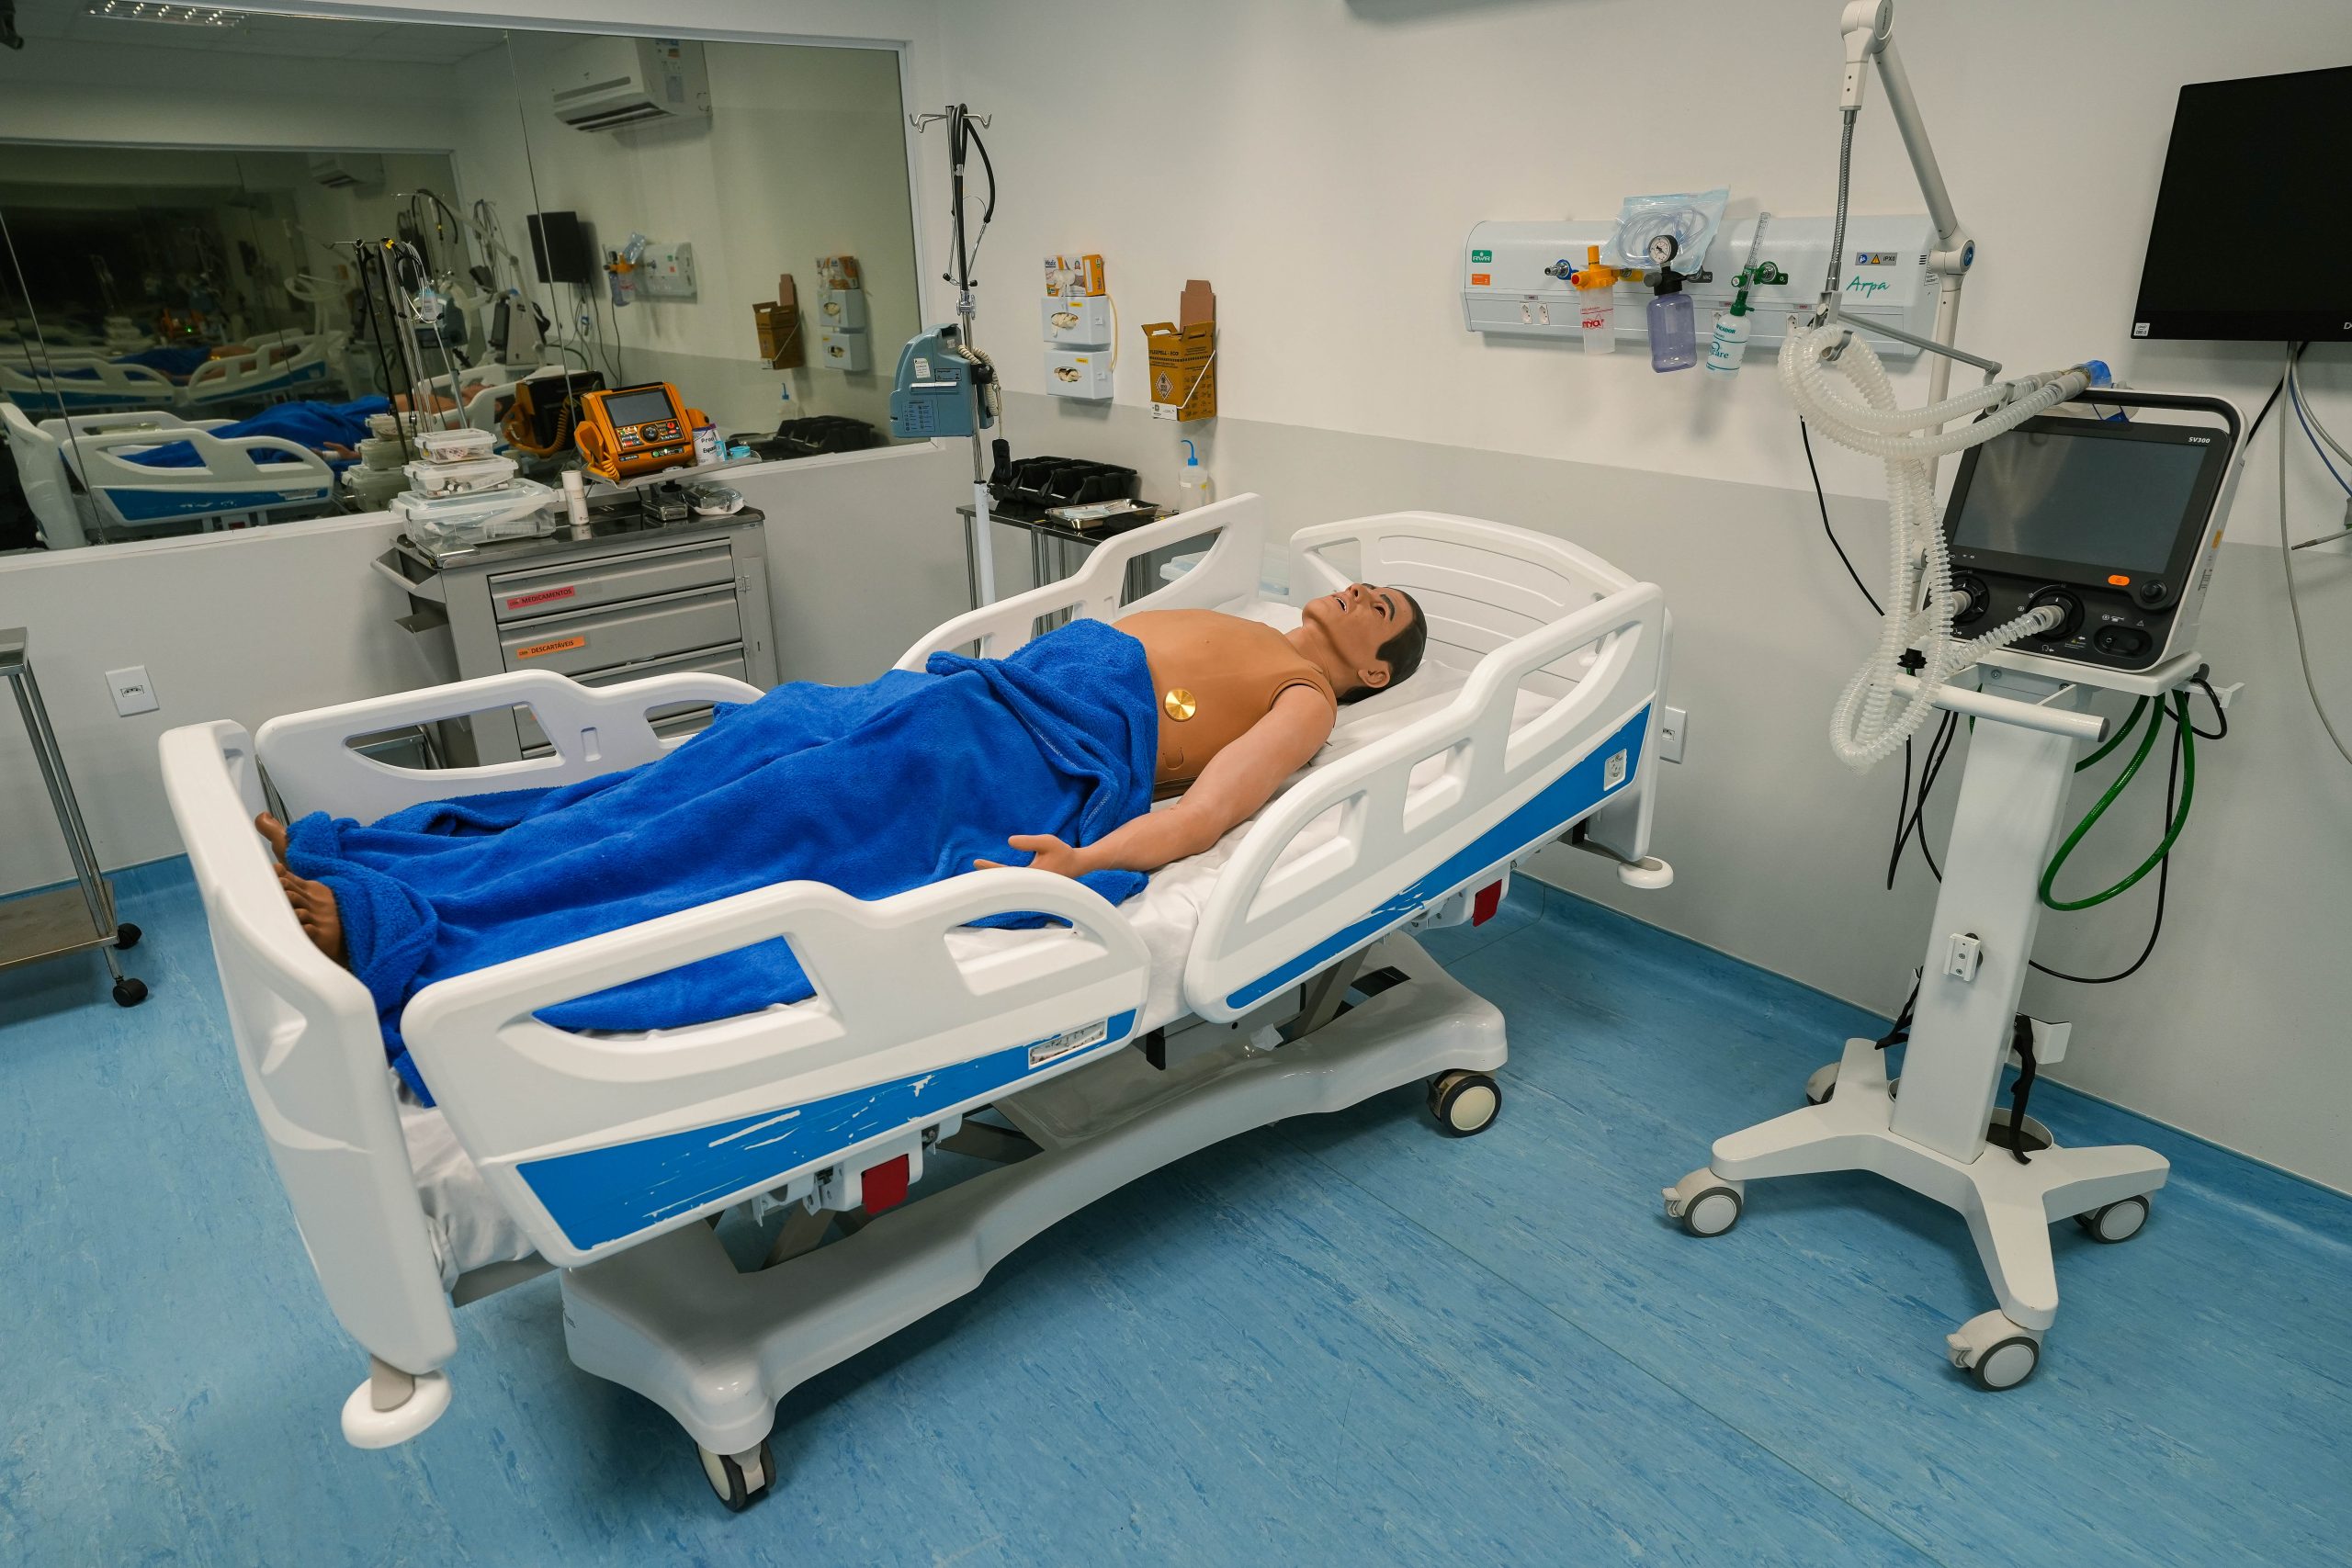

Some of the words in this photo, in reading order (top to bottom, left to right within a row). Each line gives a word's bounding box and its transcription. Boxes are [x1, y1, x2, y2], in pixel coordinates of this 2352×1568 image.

[1846, 276, 1890, 299] Arpa
[522, 588, 572, 604] MEDICAMENTOS
[531, 640, 574, 654] DESCARTÁVEIS
